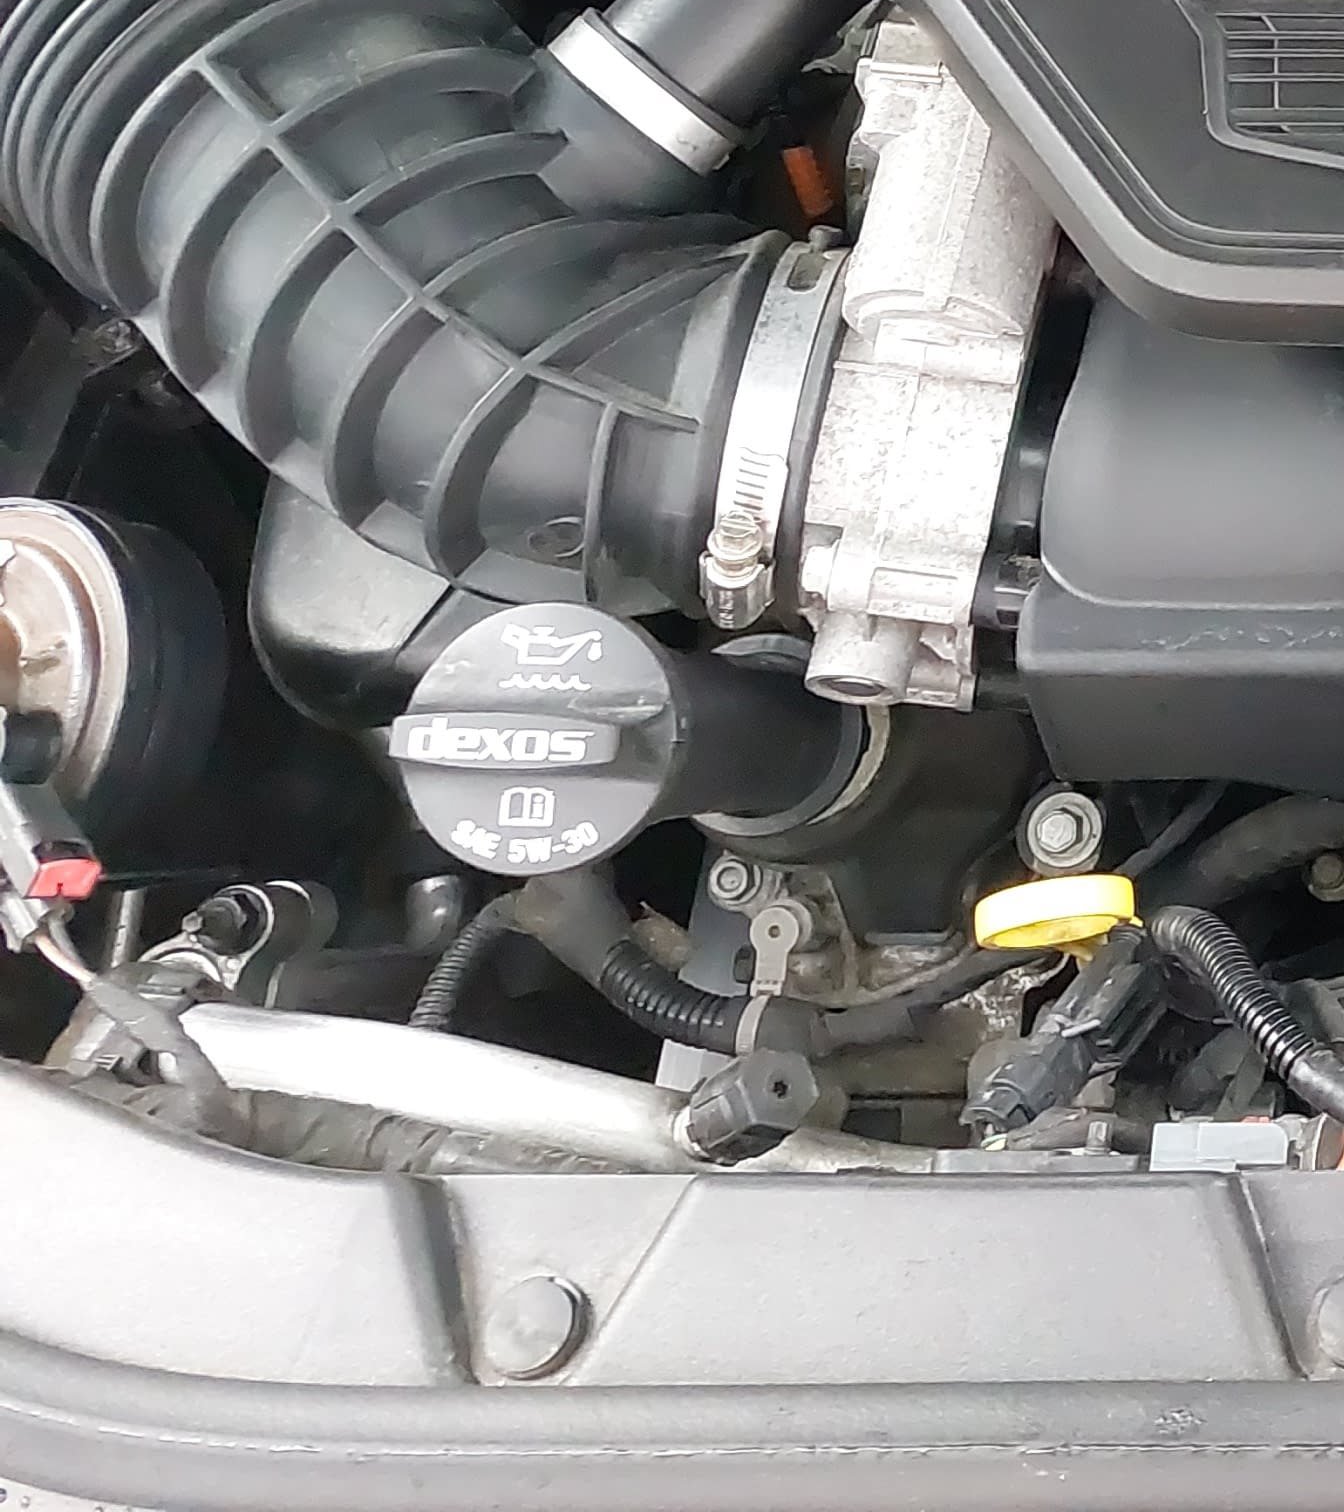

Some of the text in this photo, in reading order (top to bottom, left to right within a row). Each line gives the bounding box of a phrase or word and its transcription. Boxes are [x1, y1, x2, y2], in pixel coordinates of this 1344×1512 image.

[408, 717, 596, 762] dexos
[451, 820, 600, 864] SAE 5W-30
